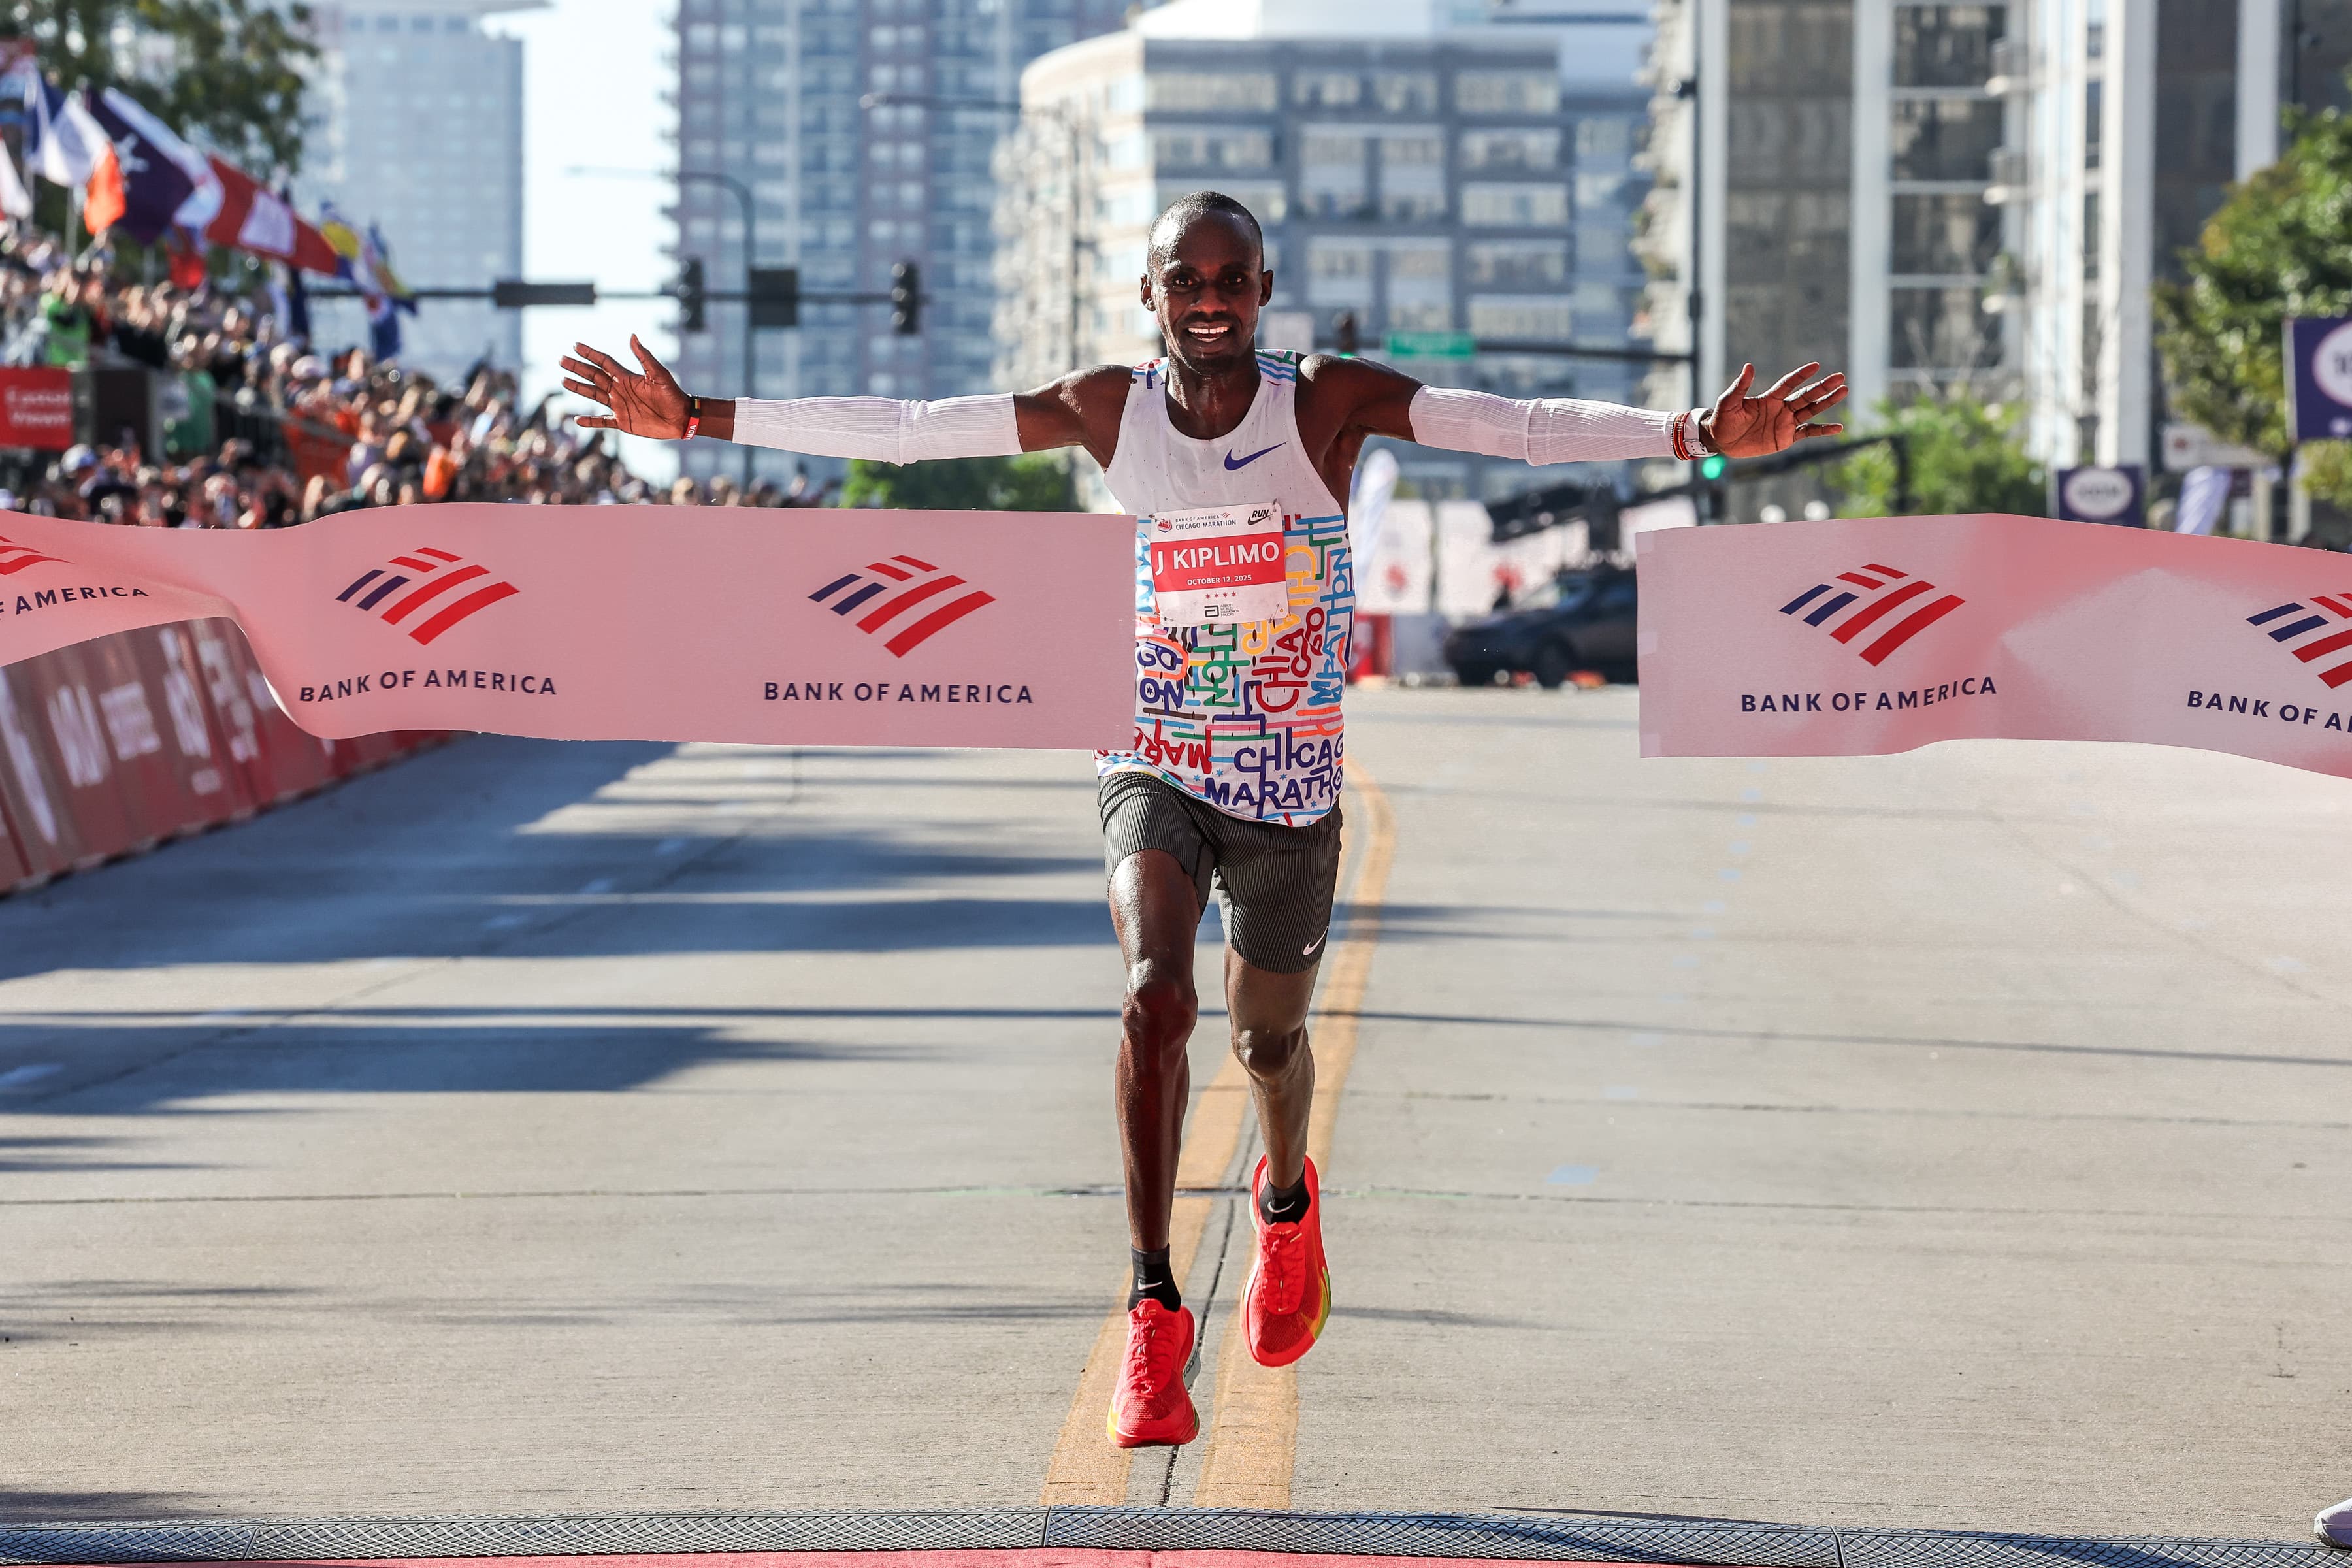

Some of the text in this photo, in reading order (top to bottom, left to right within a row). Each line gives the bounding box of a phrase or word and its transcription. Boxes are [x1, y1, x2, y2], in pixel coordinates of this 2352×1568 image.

[1176, 519, 1237, 531] CHICAGO MARATHON
[1252, 509, 1269, 518] RUN
[1154, 542, 1280, 576] J KIPLIMO
[1187, 577, 1220, 586] OCTOBER
[1222, 576, 1233, 584] 12,
[16, 587, 149, 615] AMERICA
[299, 674, 371, 702] BANK
[380, 670, 416, 689] OF
[423, 669, 557, 696] AMERICA
[764, 681, 1034, 704] BANK OF AMERICA
[1741, 676, 1997, 713] BANK OF AMERICA
[2187, 690, 2271, 718] BANK
[2279, 704, 2319, 725] OF
